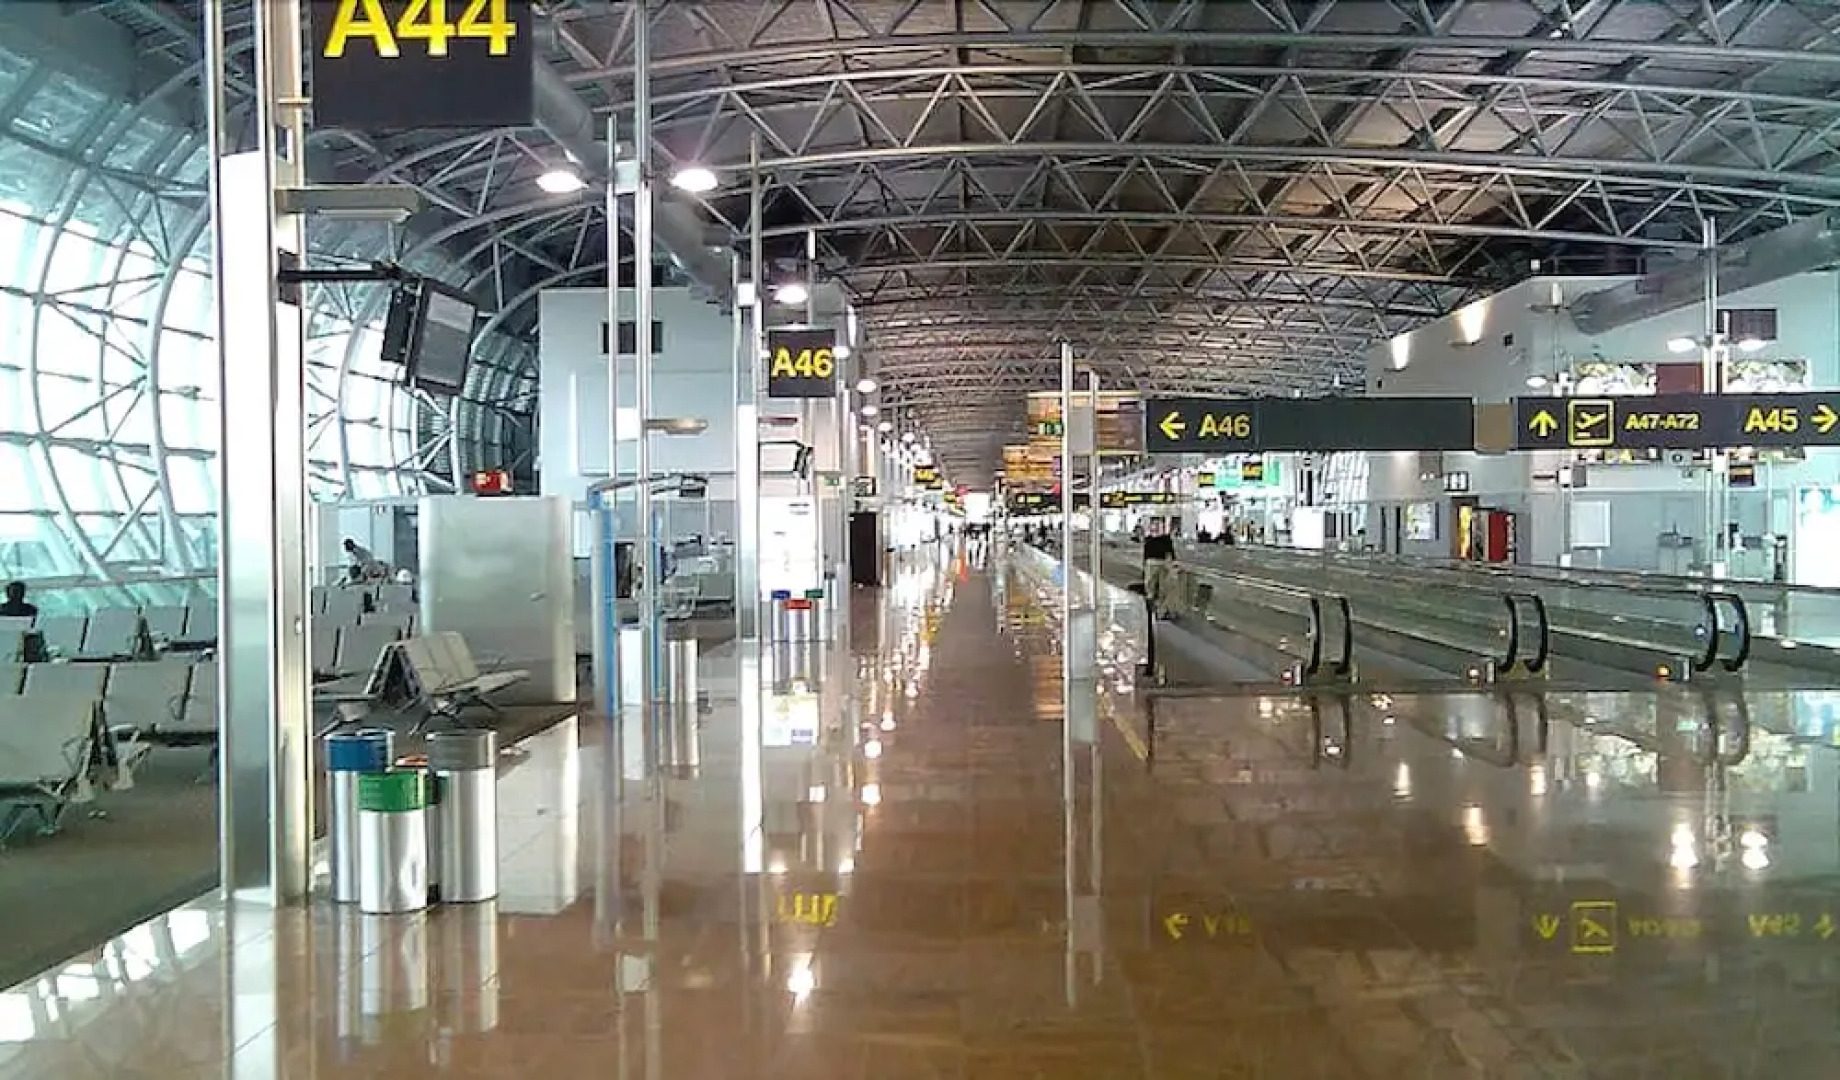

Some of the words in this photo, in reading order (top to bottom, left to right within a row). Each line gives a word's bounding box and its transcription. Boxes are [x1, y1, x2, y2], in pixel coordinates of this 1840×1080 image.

[323, 0, 517, 57] A44
[771, 346, 834, 378] A46
[1198, 413, 1251, 438] A46
[1624, 413, 1700, 431] A47-A72
[1743, 407, 1799, 433] A45
